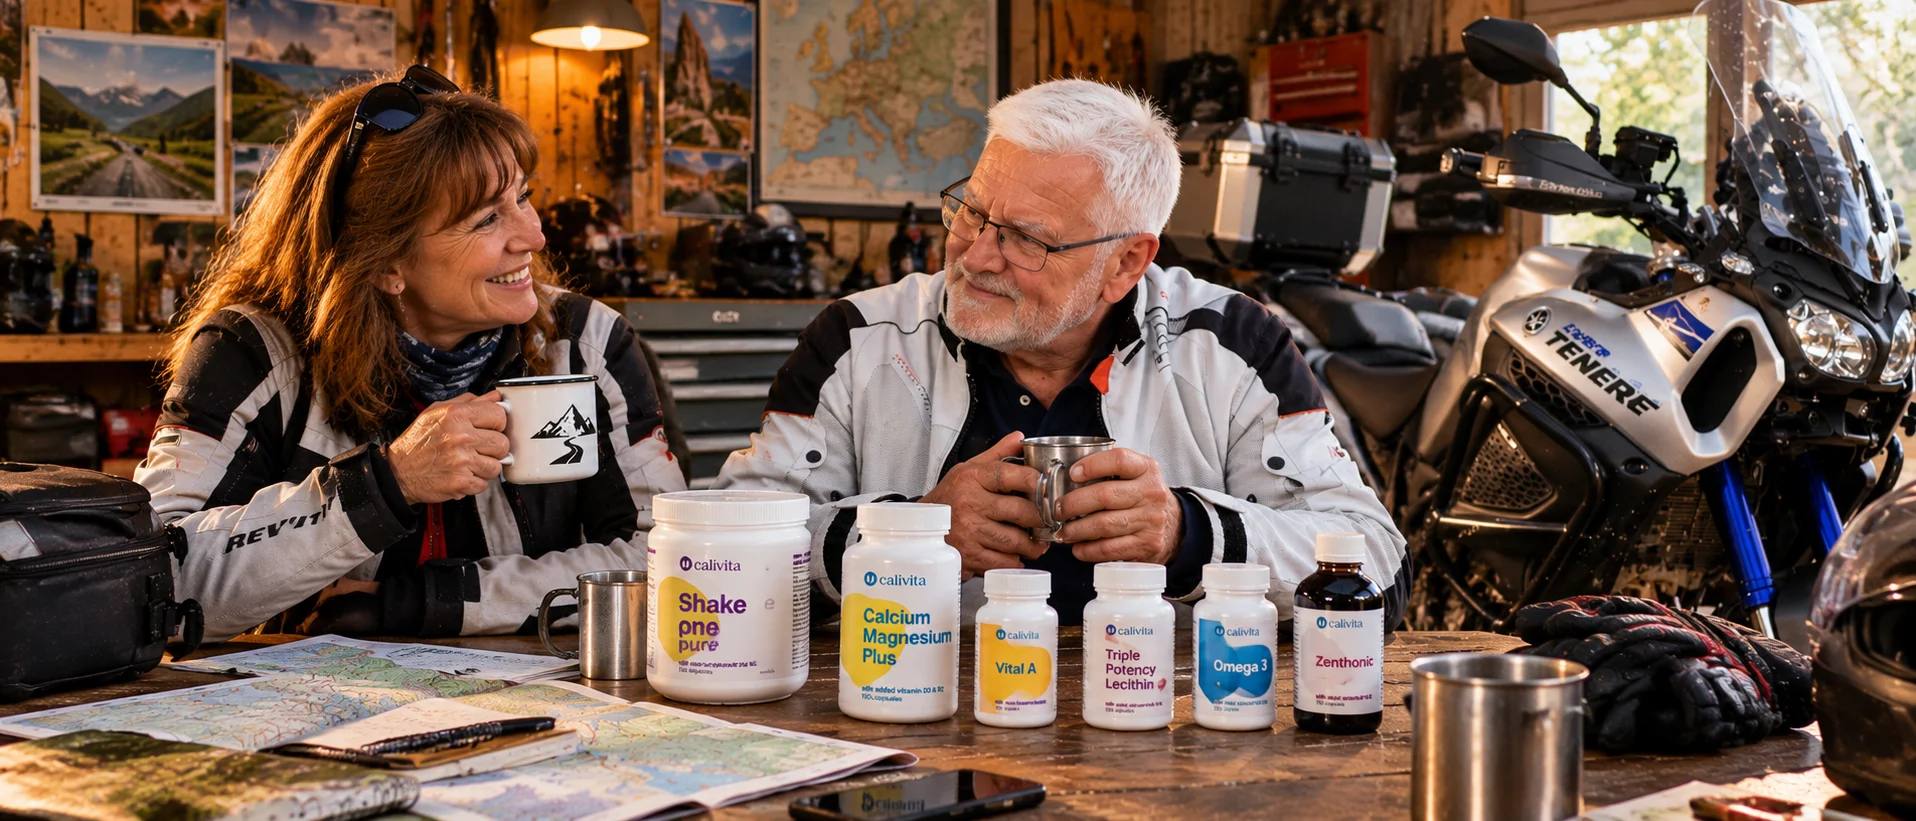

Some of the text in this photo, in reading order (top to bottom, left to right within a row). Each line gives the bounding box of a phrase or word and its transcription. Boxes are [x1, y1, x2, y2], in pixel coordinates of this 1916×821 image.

[1545, 330, 1661, 417] TENERE
[693, 559, 742, 572] calivita
[879, 575, 927, 587] calivita
[678, 592, 747, 614] Shake
[863, 607, 931, 625] Calcium
[1117, 626, 1154, 636] calivita
[1328, 619, 1363, 629] calivita
[863, 628, 952, 648] Magnesium
[1007, 630, 1040, 640] calivita
[1226, 627, 1260, 637] calivita
[862, 648, 897, 665] Plus
[1105, 648, 1141, 663] Triple
[1315, 655, 1374, 669] Zenthonic
[995, 661, 1037, 675] Vital A
[1105, 663, 1157, 676] Potency
[1213, 658, 1268, 676] Omega 3
[1105, 678, 1155, 690] Lecithin
